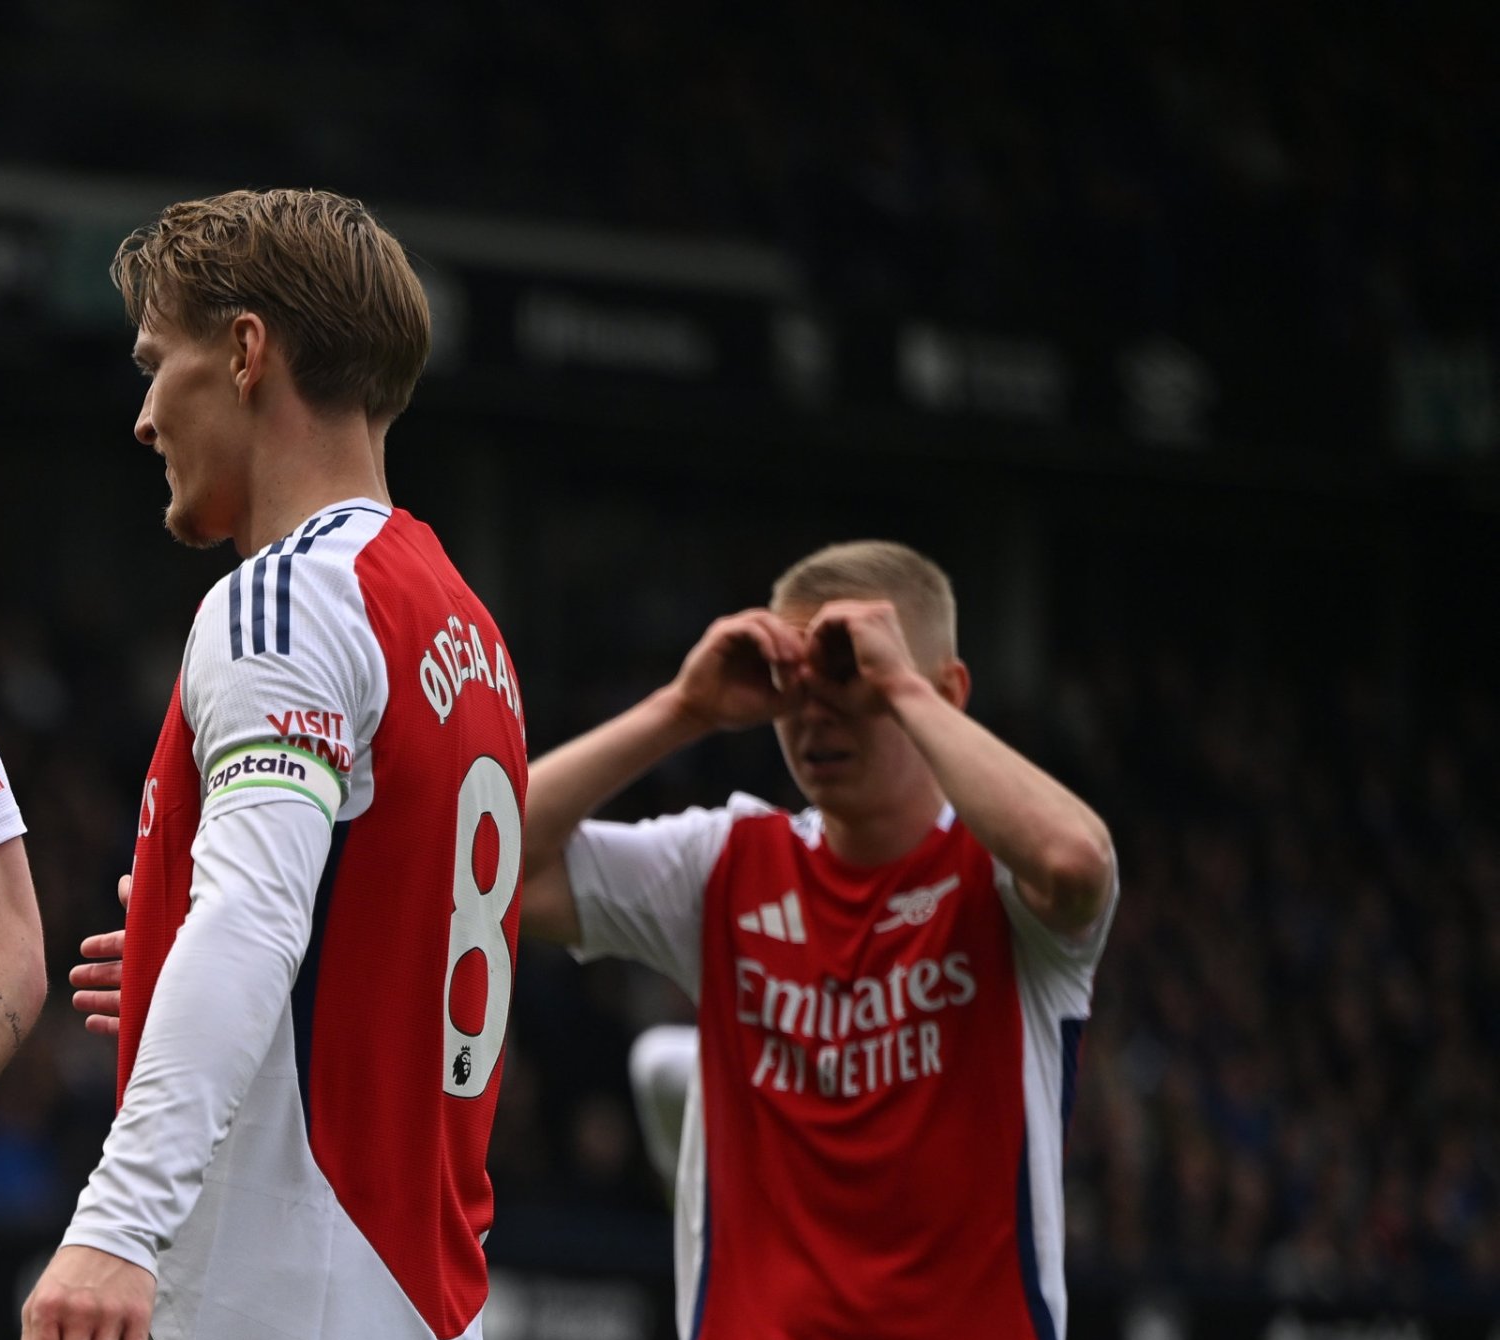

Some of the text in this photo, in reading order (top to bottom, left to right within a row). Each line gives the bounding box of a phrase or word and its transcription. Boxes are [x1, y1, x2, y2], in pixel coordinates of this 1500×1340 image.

[266, 710, 343, 740] VISIT
[207, 753, 306, 795] captain
[442, 754, 522, 1099] 8
[735, 951, 977, 1042] Emirates
[751, 1019, 943, 1098] FLY BETTER
